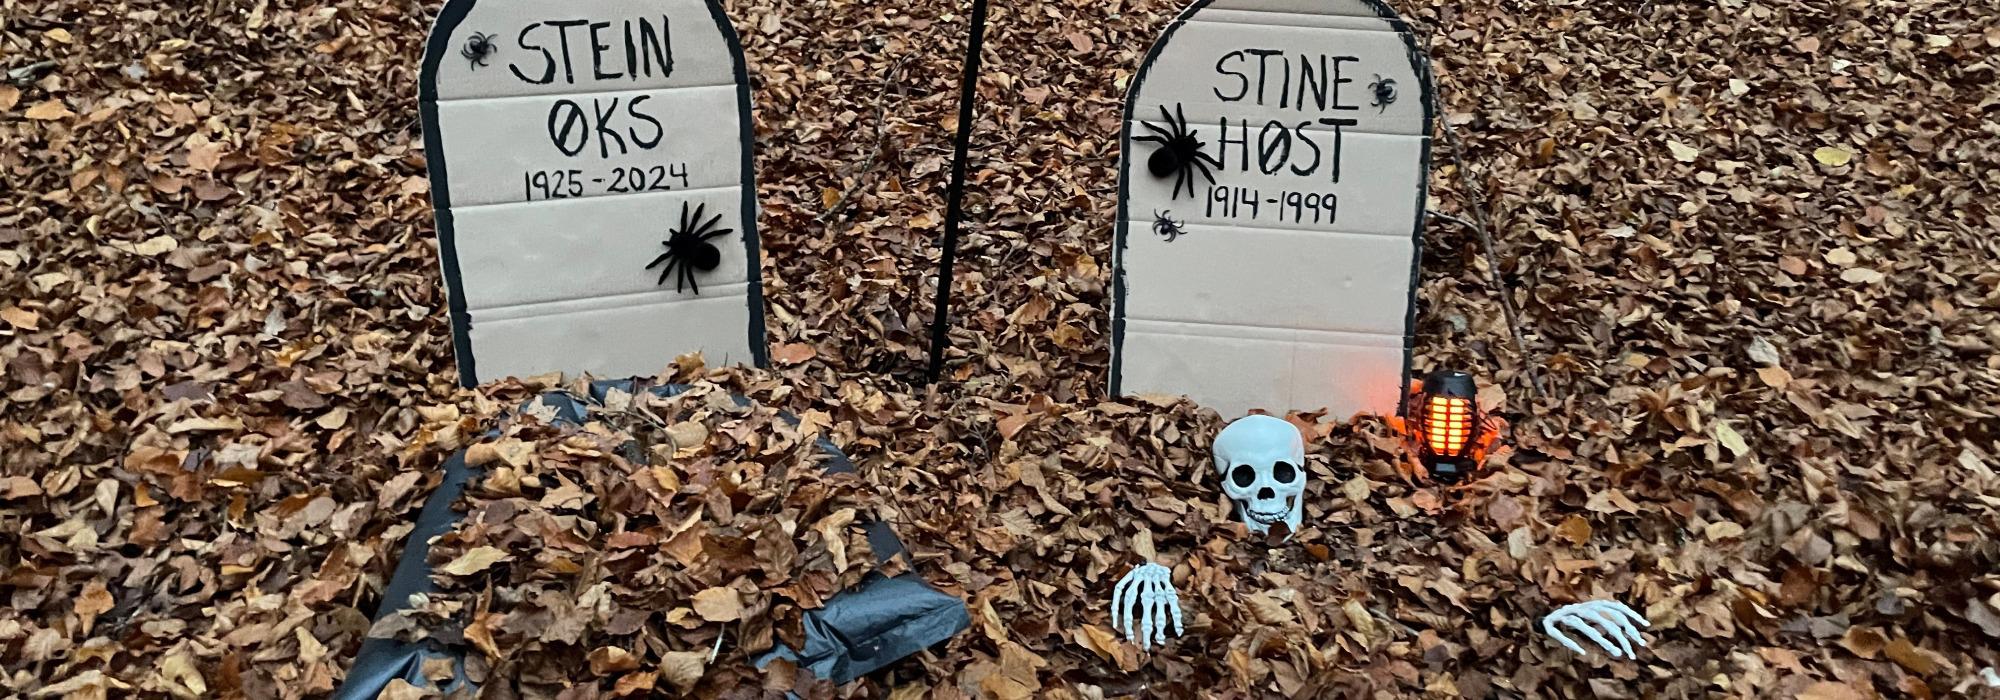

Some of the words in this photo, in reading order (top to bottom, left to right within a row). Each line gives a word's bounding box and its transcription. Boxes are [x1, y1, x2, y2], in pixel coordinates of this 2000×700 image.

[508, 14, 674, 84] STEIN
[1213, 48, 1359, 111] STINE
[547, 94, 664, 158] ØKS
[1217, 116, 1358, 184] HØST
[1206, 185, 1337, 224] 1914-1999
